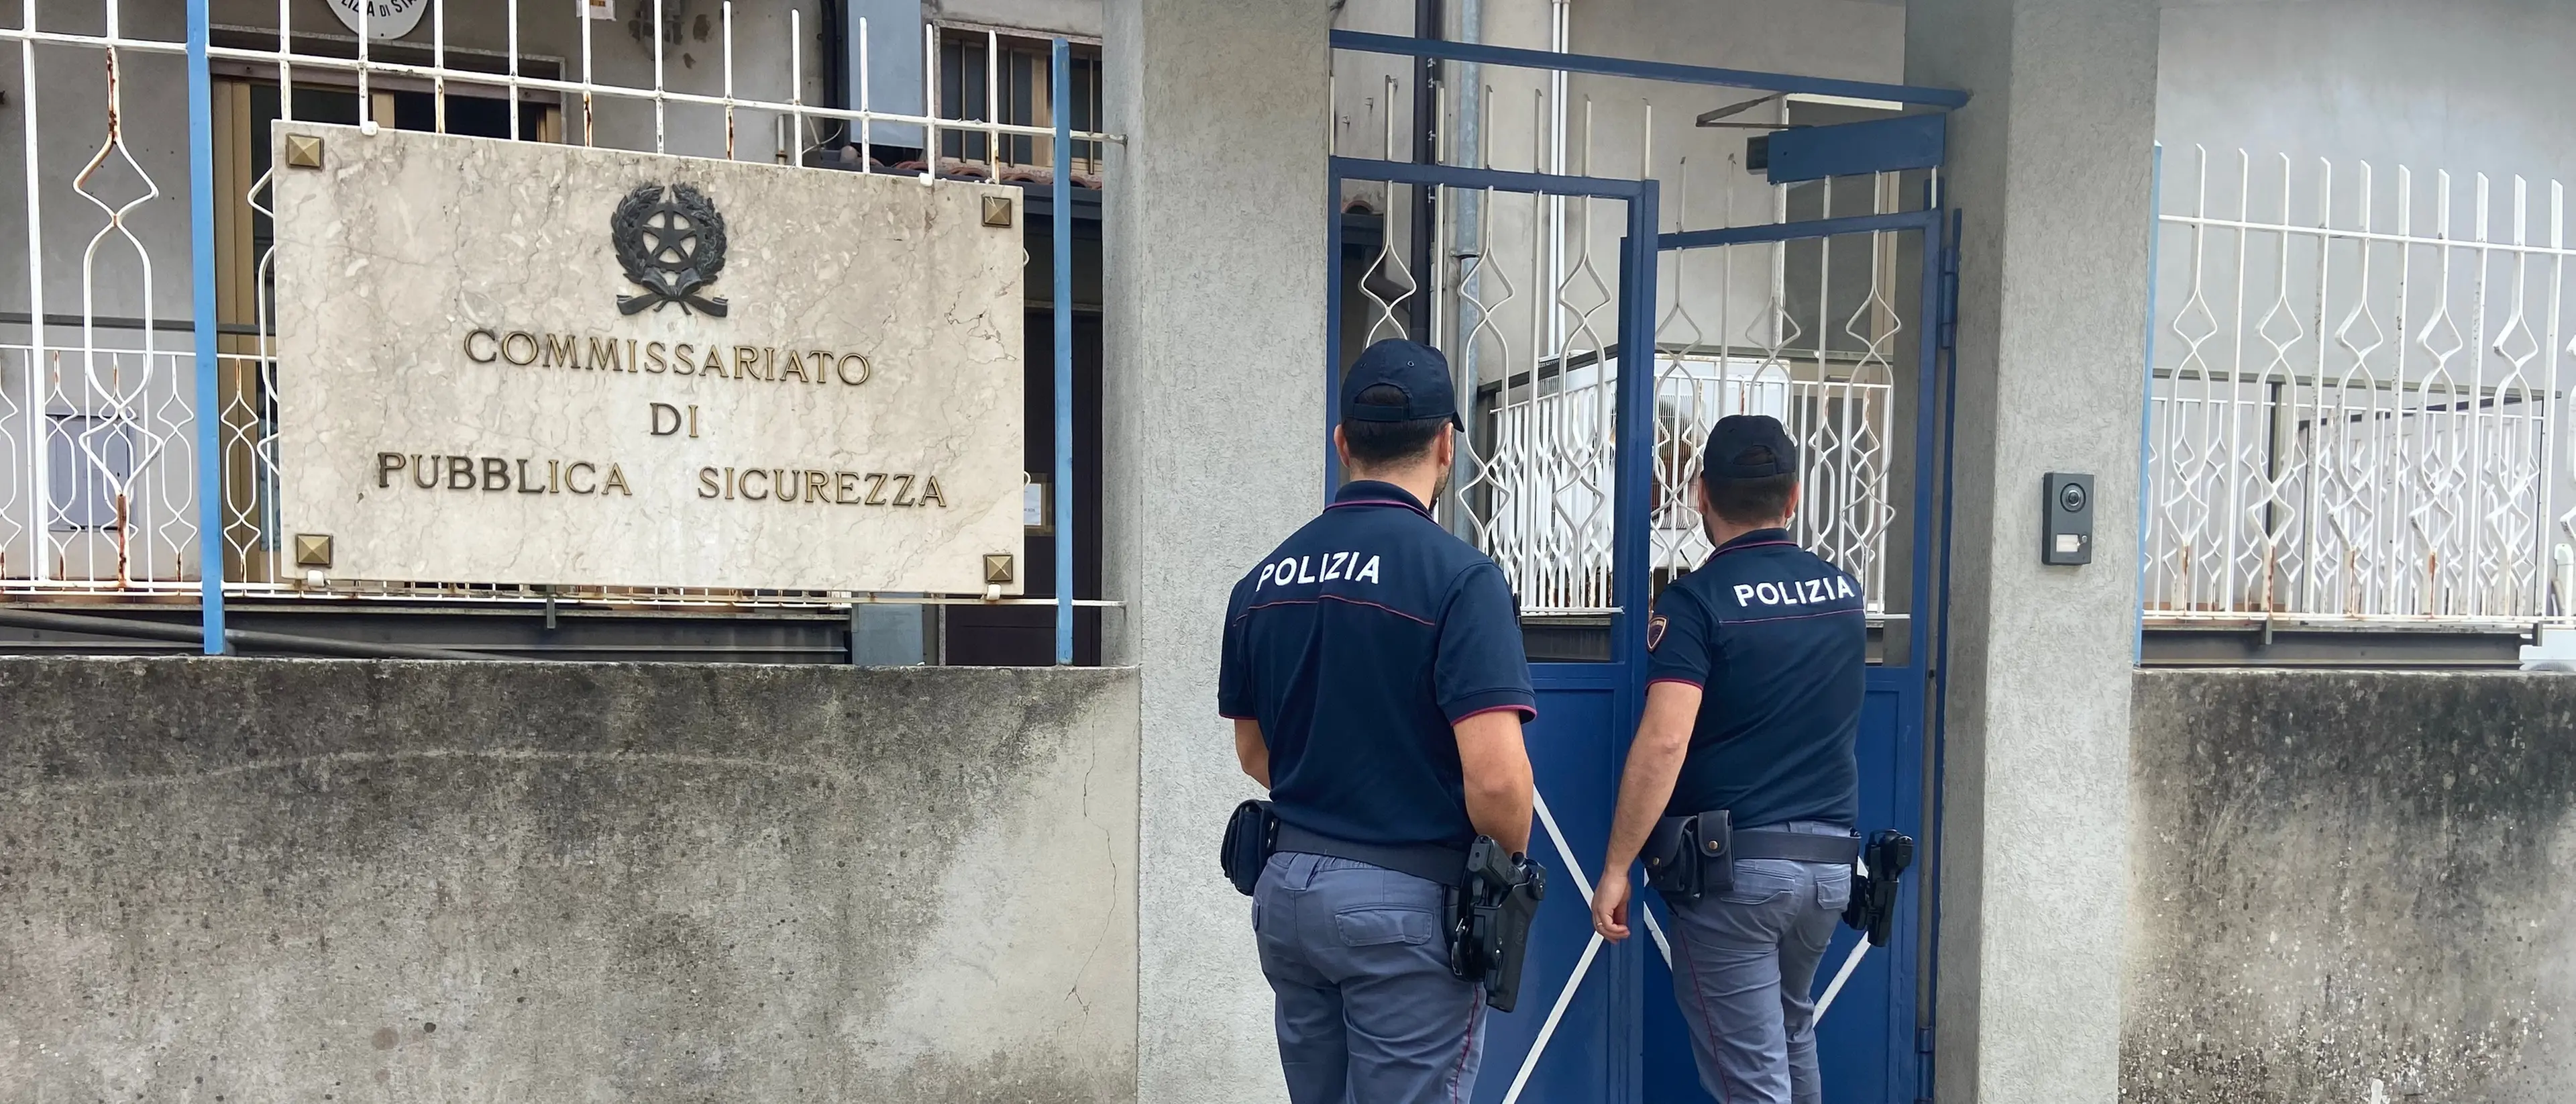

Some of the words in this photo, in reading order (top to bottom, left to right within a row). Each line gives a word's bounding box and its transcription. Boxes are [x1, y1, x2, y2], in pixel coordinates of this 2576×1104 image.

[379, 5, 390, 17] DI
[464, 329, 871, 385] COMMISSARIATO
[649, 402, 700, 438] DI
[377, 452, 633, 496] PUBBLICA
[698, 467, 947, 507] SICUREZZA
[1255, 551, 1380, 592] POLIZIA
[1733, 575, 1855, 607] POLIZIA
